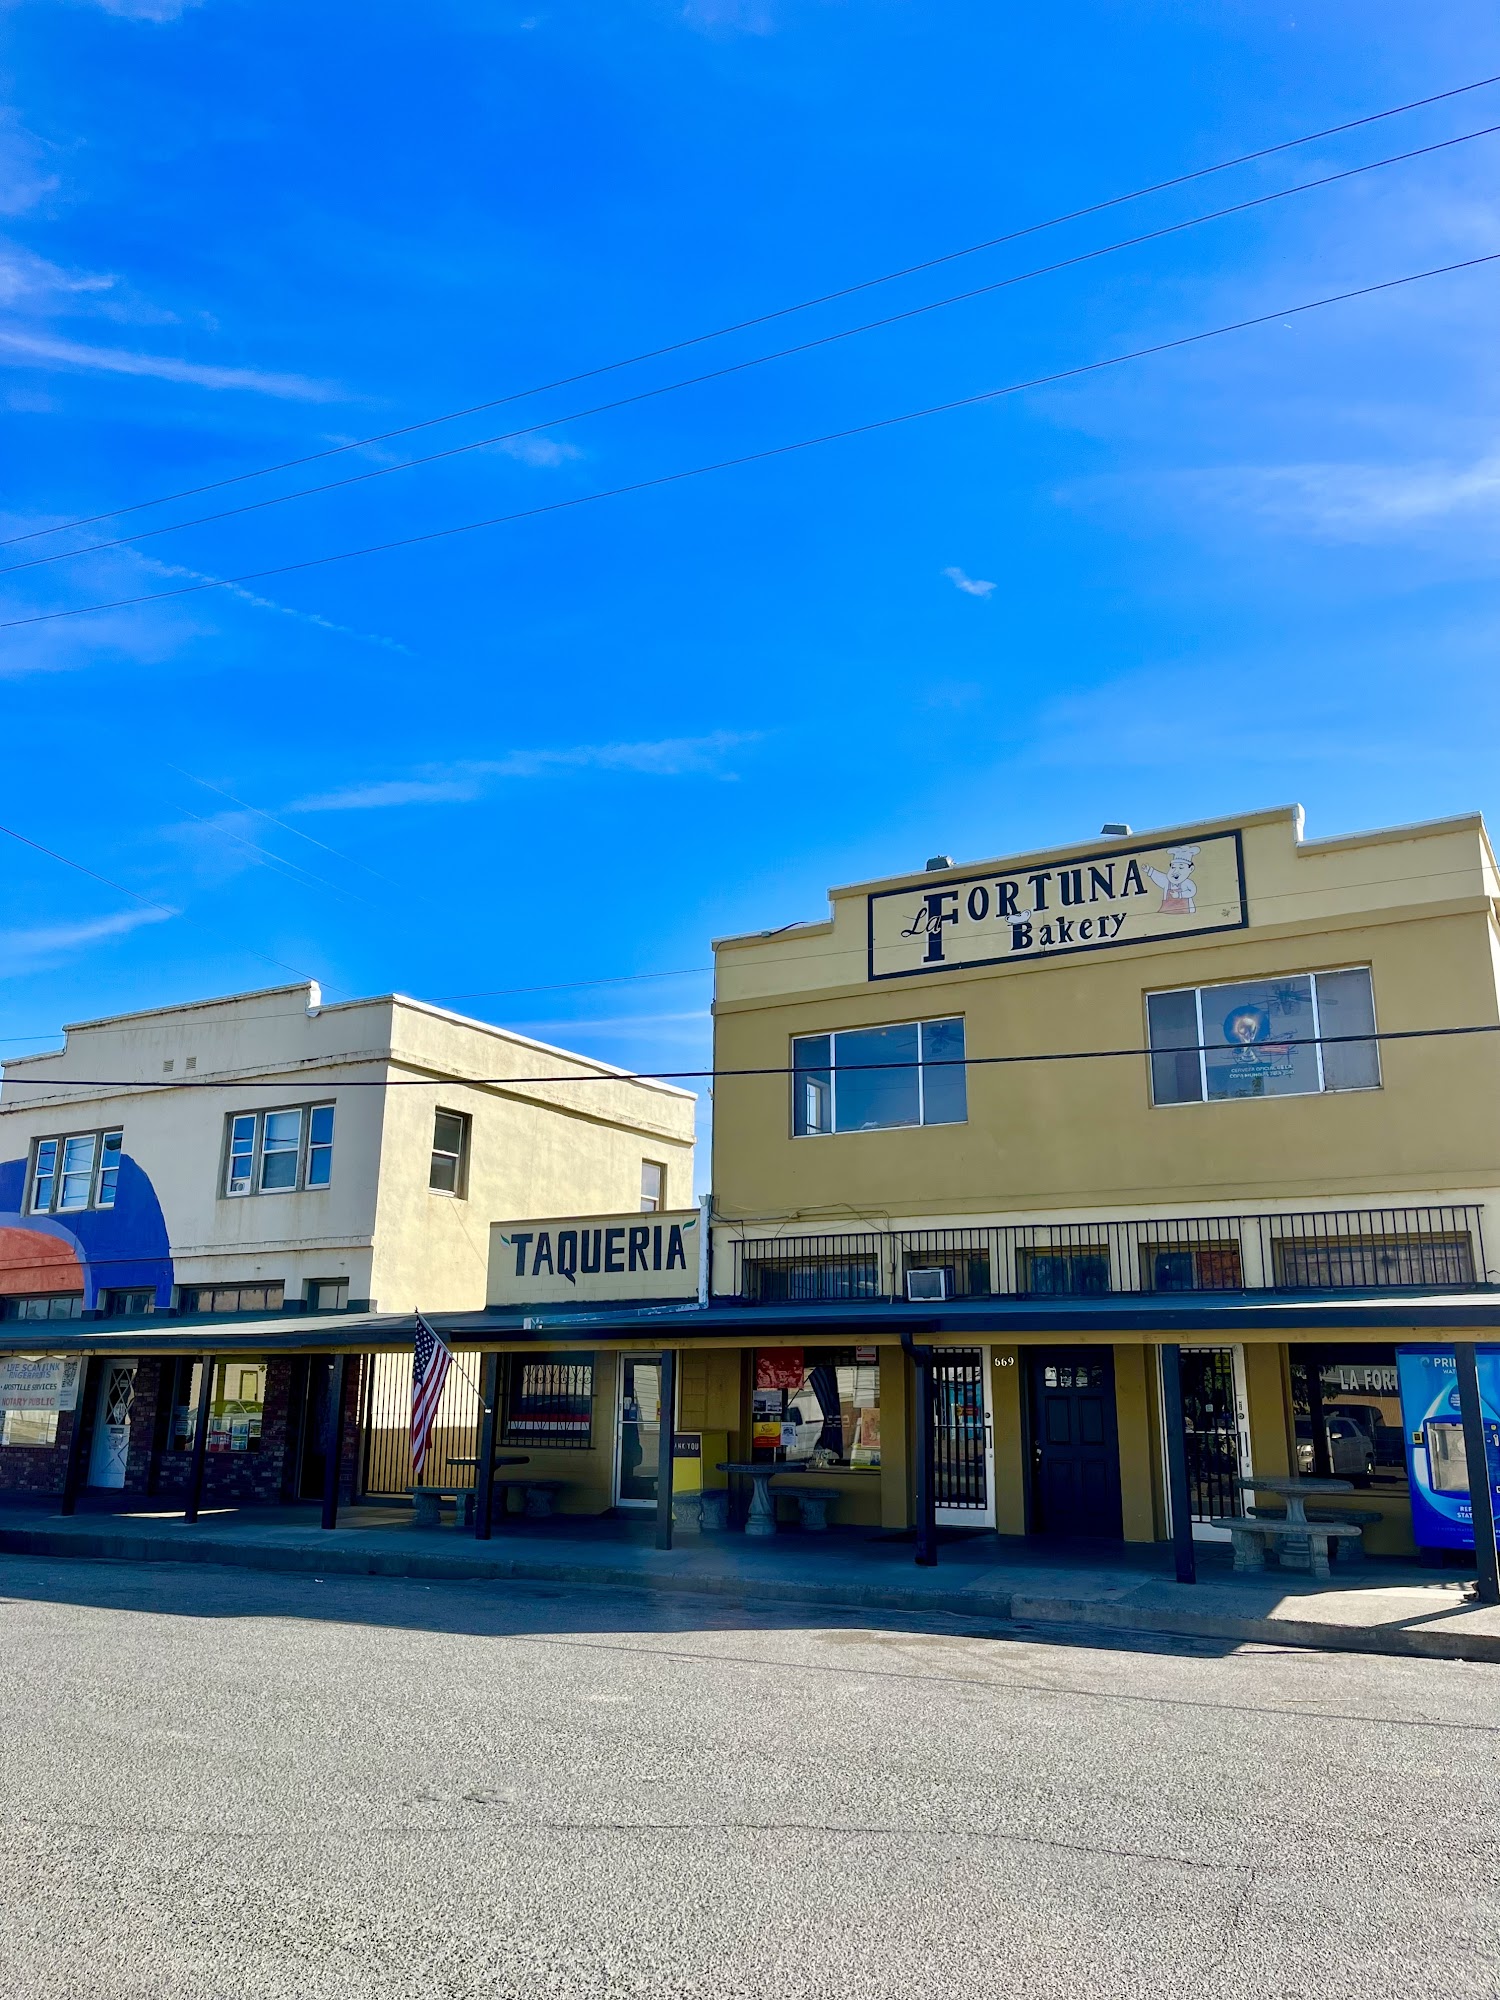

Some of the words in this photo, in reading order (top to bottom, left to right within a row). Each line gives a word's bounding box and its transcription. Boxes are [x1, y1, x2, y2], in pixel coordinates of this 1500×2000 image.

[900, 906, 942, 939] La
[922, 858, 1148, 963] FORTUNA
[1009, 912, 1128, 951] Bakery
[510, 1224, 687, 1288] TAQUERIA
[994, 1356, 1014, 1367] 669
[1339, 1369, 1360, 1390] LA
[1363, 1369, 1399, 1391] FORT
[1, 1397, 28, 1407] NOTARY
[28, 1397, 55, 1406] PUBLIC
[687, 1442, 700, 1451] YOU
